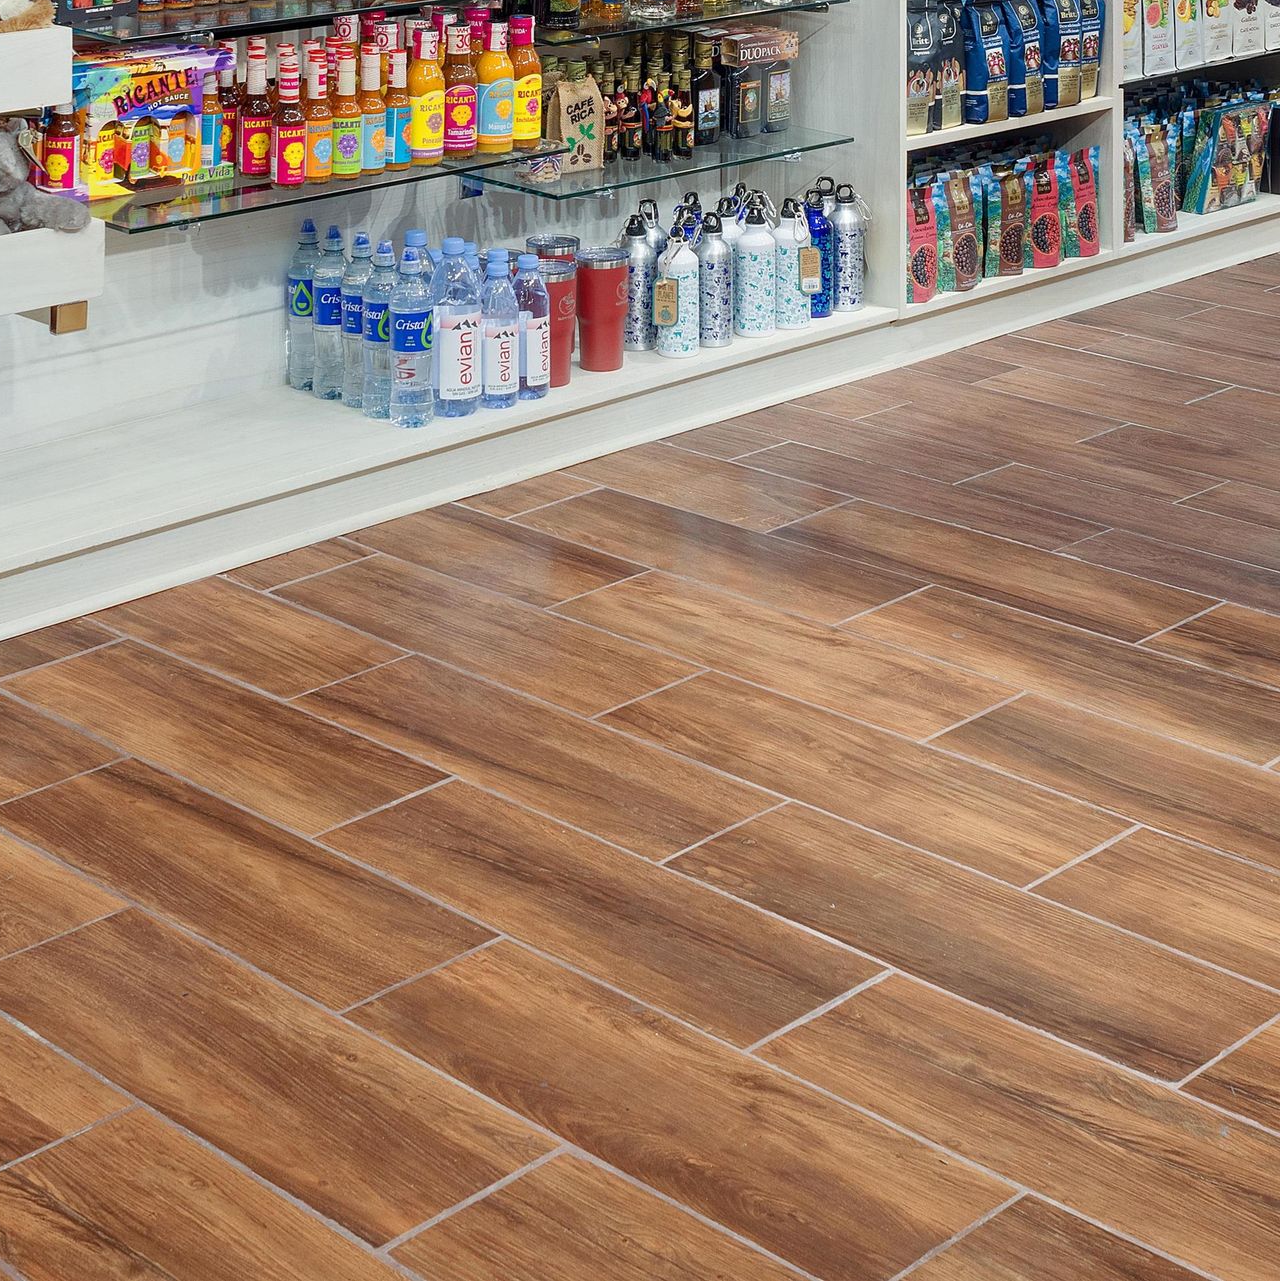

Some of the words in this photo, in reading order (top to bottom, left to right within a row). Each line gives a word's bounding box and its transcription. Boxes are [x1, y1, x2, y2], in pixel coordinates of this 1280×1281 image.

[1060, 10, 1077, 19] Britt
[147, 99, 163, 112] HOT
[164, 93, 189, 104] SAUCE
[445, 95, 476, 105] RICANTE
[570, 106, 595, 125] RICA
[181, 171, 204, 184] Pura
[208, 168, 230, 179] Vida
[396, 319, 426, 331] Cristal
[456, 331, 473, 385] evian
[500, 340, 511, 382] evian
